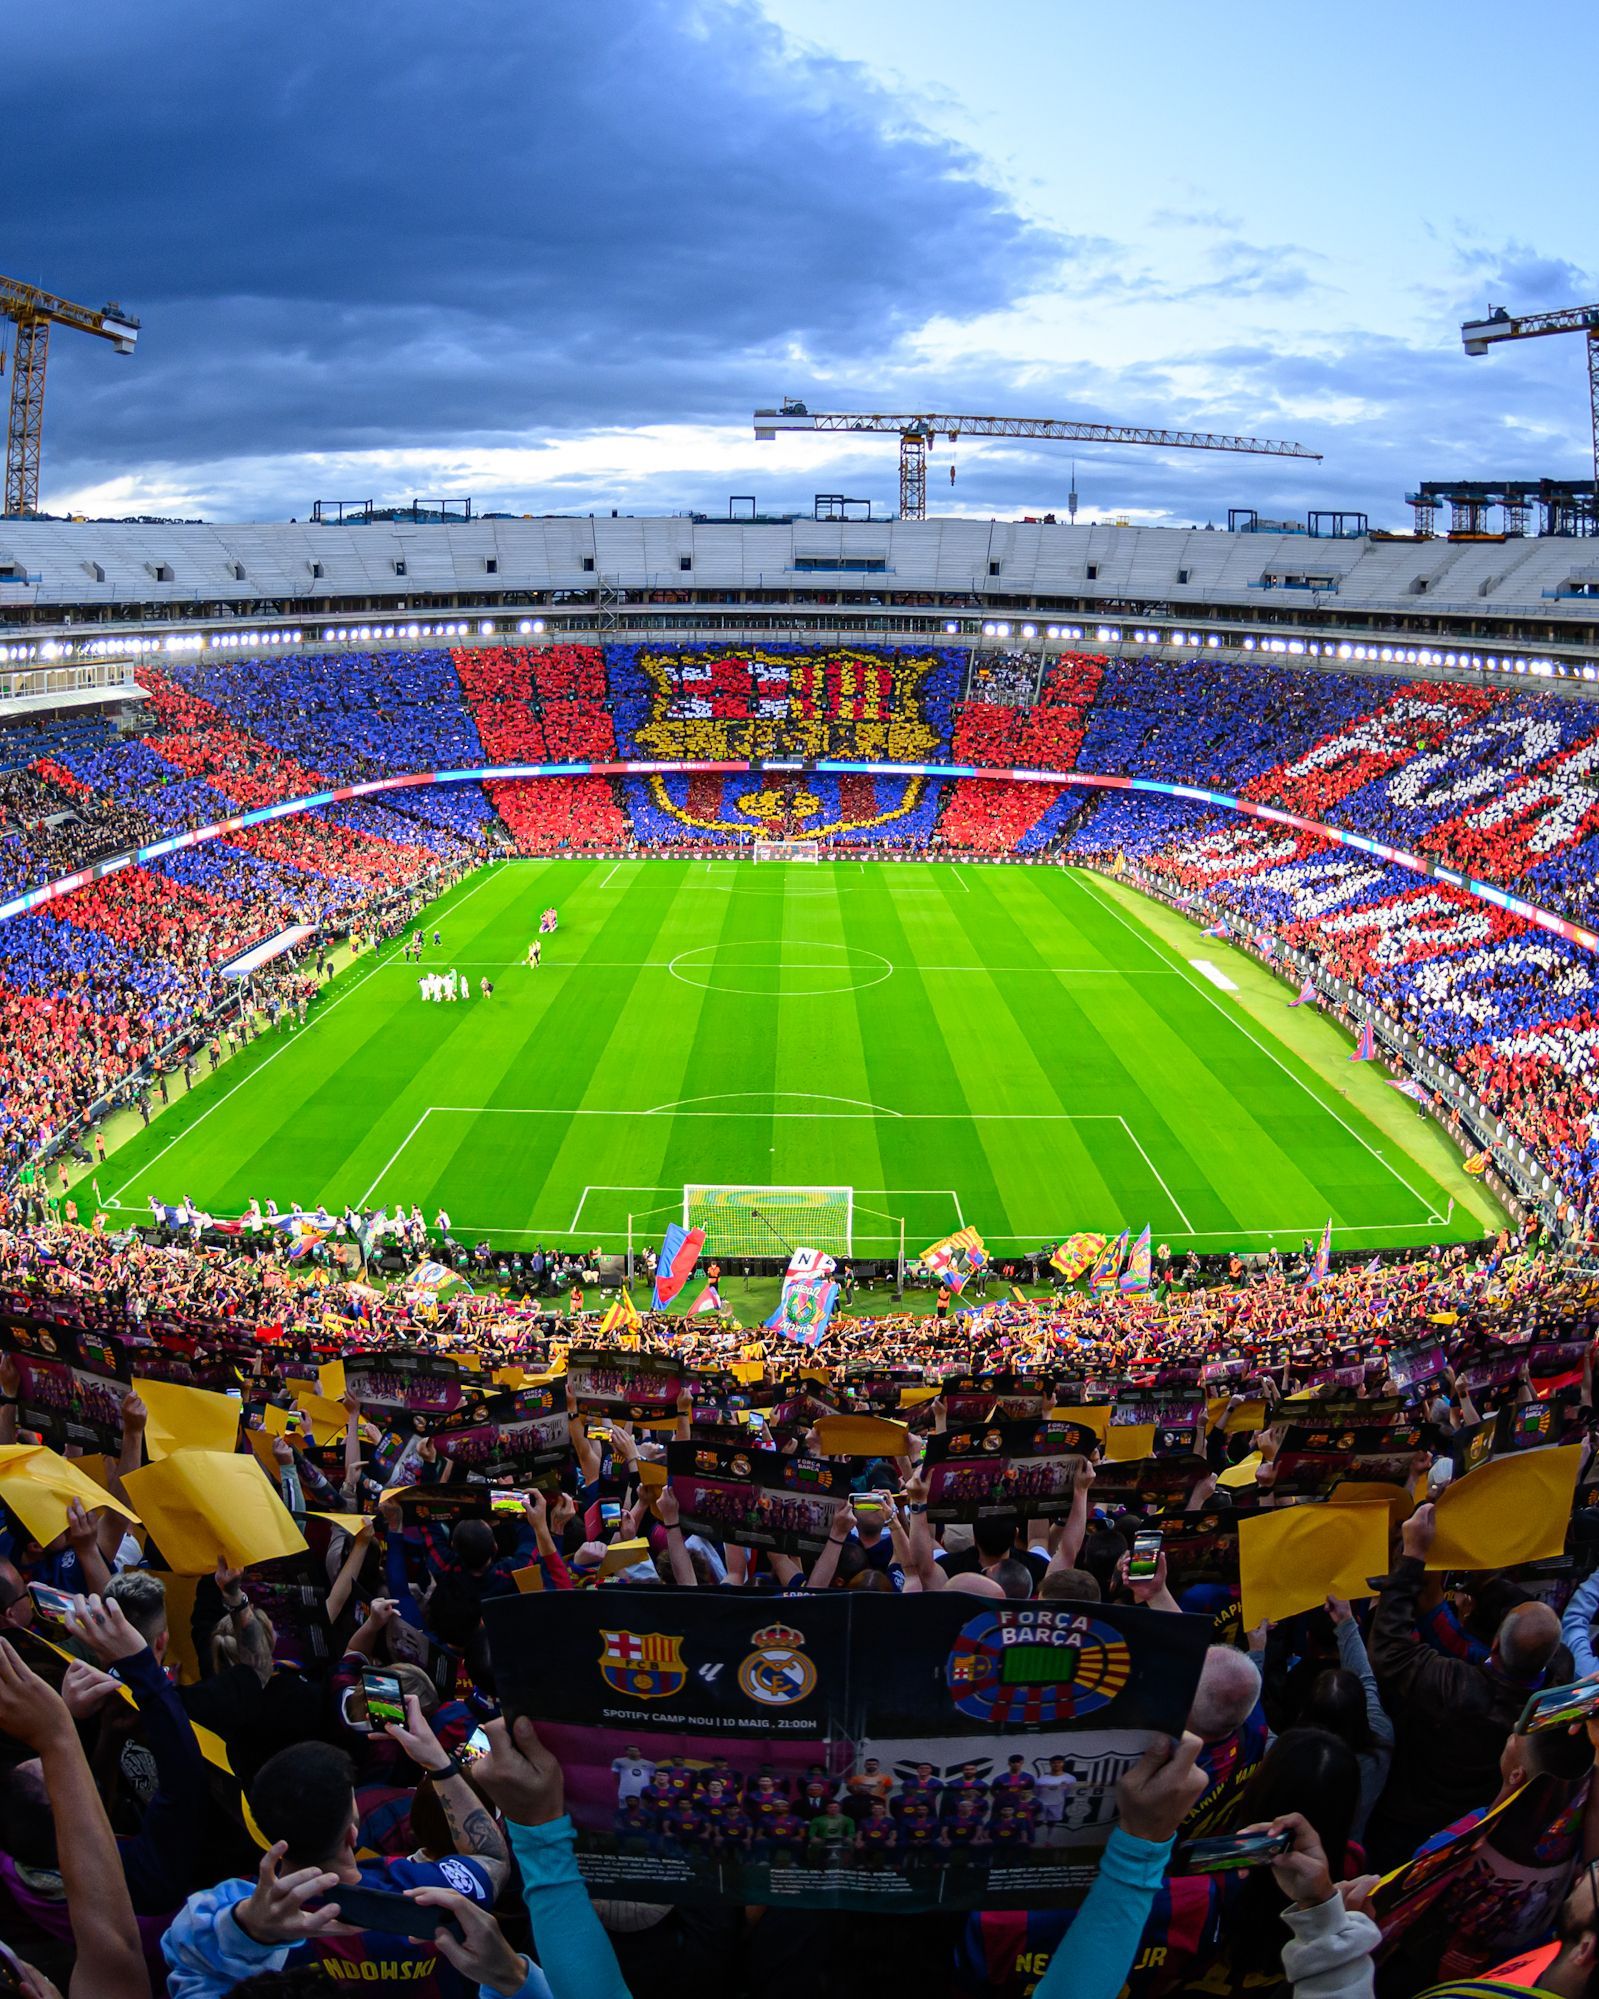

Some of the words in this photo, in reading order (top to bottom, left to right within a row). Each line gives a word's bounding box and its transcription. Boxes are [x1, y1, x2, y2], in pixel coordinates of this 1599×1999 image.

[1000, 1610, 1089, 1631] FORÇA
[1002, 1627, 1082, 1647] BARÇA
[626, 1660, 660, 1671] FCB
[602, 1708, 649, 1721] SPOTIFY
[652, 1713, 687, 1724] CAMP
[688, 1716, 714, 1727] NOU
[722, 1718, 736, 1727] 10
[777, 1719, 817, 1729] 21:00H
[310, 1957, 437, 1981] NDOWSKI
